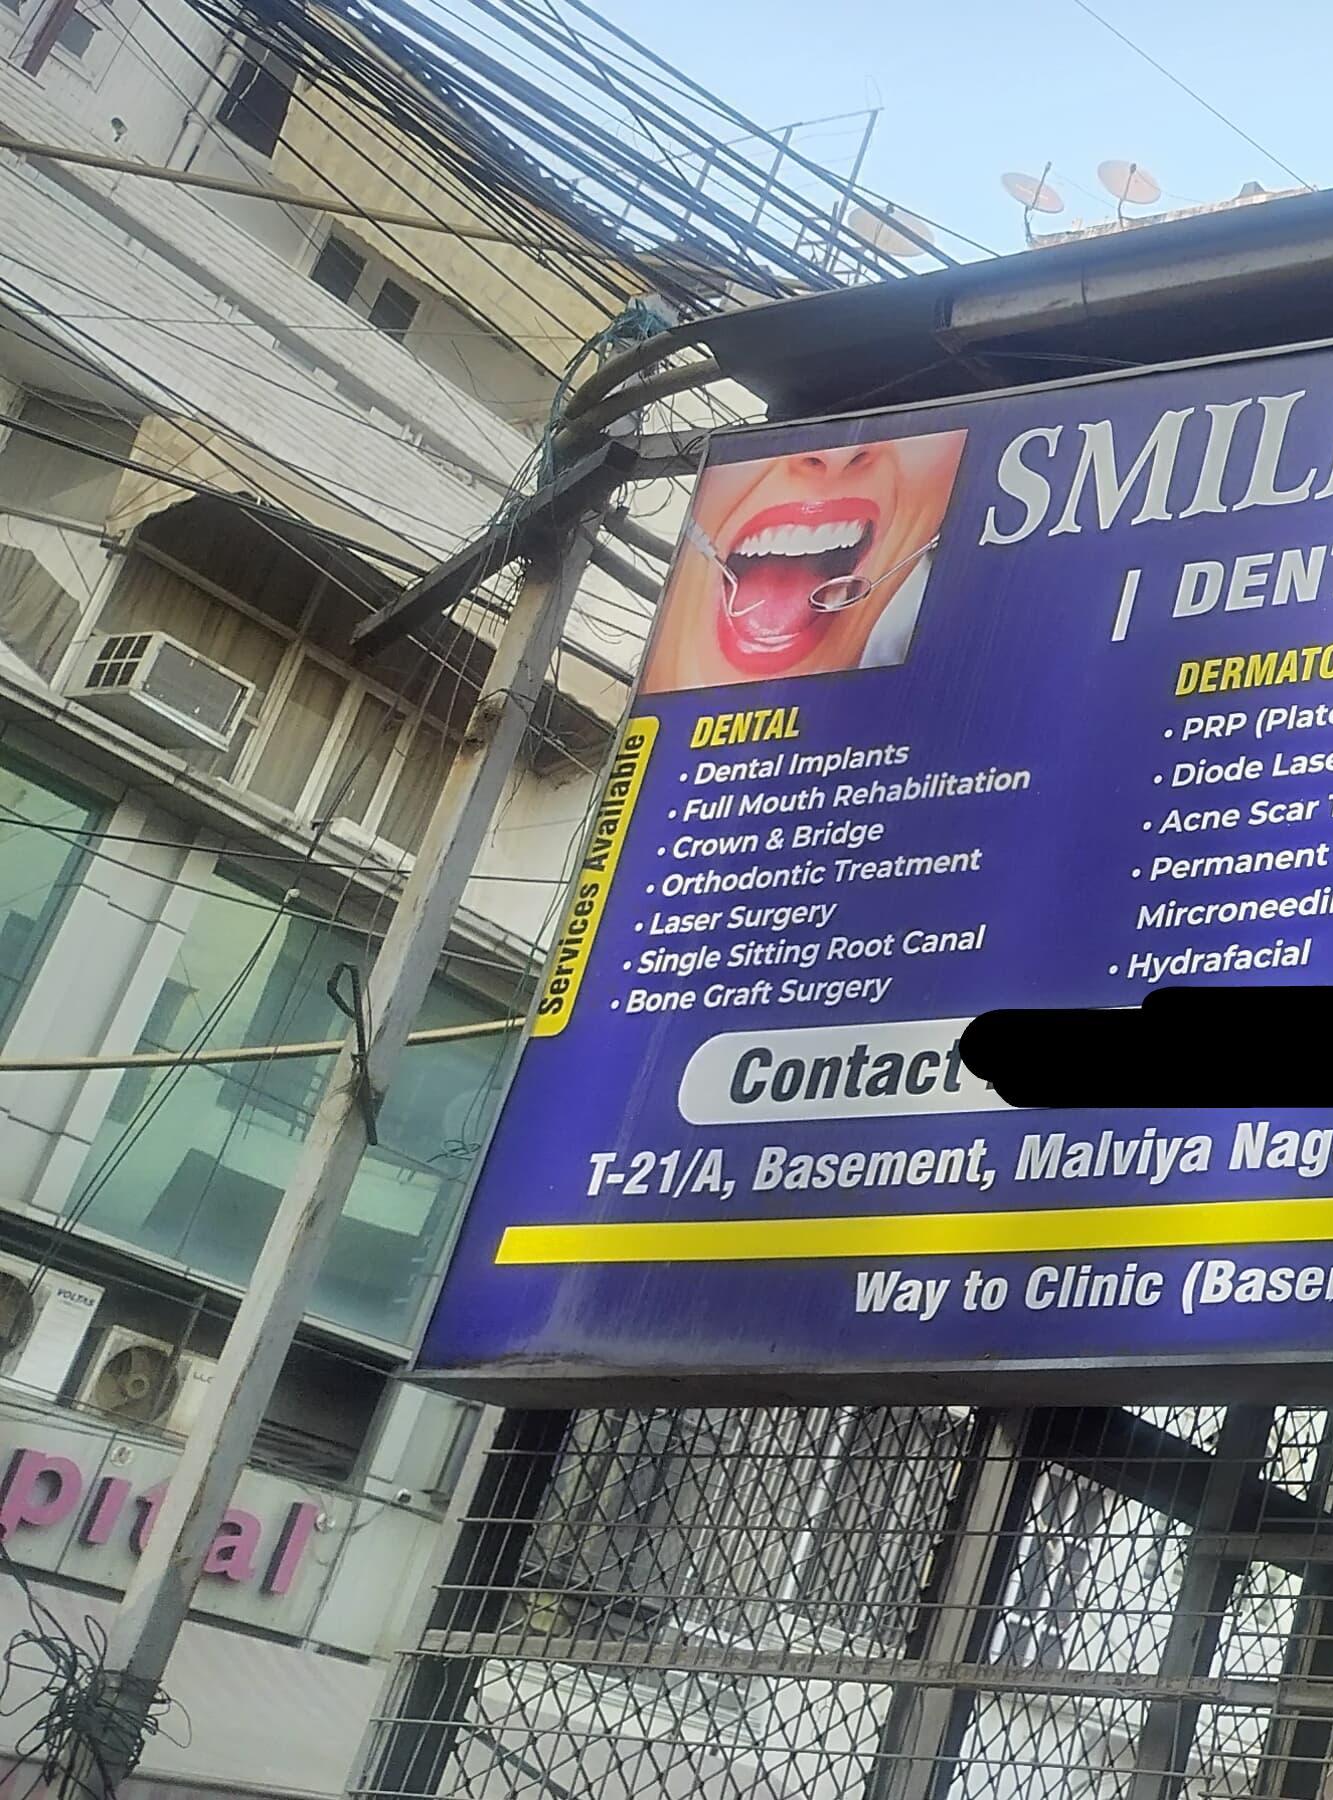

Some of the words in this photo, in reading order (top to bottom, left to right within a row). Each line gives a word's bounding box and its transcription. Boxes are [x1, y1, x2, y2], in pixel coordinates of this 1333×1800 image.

[690, 706, 799, 749] DENTAL
[1182, 712, 1248, 741] PRP
[693, 753, 785, 785] Dental
[788, 744, 910, 778] Implants
[1171, 755, 1264, 787] Diode
[682, 794, 735, 822] Full
[737, 786, 826, 817] Mouth
[832, 766, 1031, 808] Rehabilitation
[1158, 808, 1241, 834] Acne
[1247, 799, 1320, 826] Scar
[672, 834, 759, 859] Crown
[765, 827, 785, 851] &
[791, 820, 884, 849] Bridge
[539, 882, 599, 1016] Services
[588, 733, 645, 872] Available
[661, 860, 826, 897] Orthodontic
[834, 848, 983, 883] Treatment
[1150, 843, 1330, 881] Permanent
[649, 911, 724, 936] Laser
[726, 903, 838, 932] Surgery
[636, 945, 722, 977] Single
[726, 938, 821, 968] Sitting
[826, 934, 896, 961] Root
[902, 924, 987, 955] Canal
[1127, 938, 1312, 983] Hydrafacial
[625, 989, 697, 1014] Bone
[703, 979, 773, 1008] Graft
[777, 977, 893, 1006] Surgery
[729, 1037, 963, 1105] Contact
[586, 1148, 736, 1201] T-21/A,
[751, 1138, 996, 1191] Basement,
[1014, 1127, 1213, 1185] Malviya
[855, 1270, 952, 1321] Way
[963, 1270, 1008, 1311] to
[1025, 1262, 1164, 1310] Clinic
